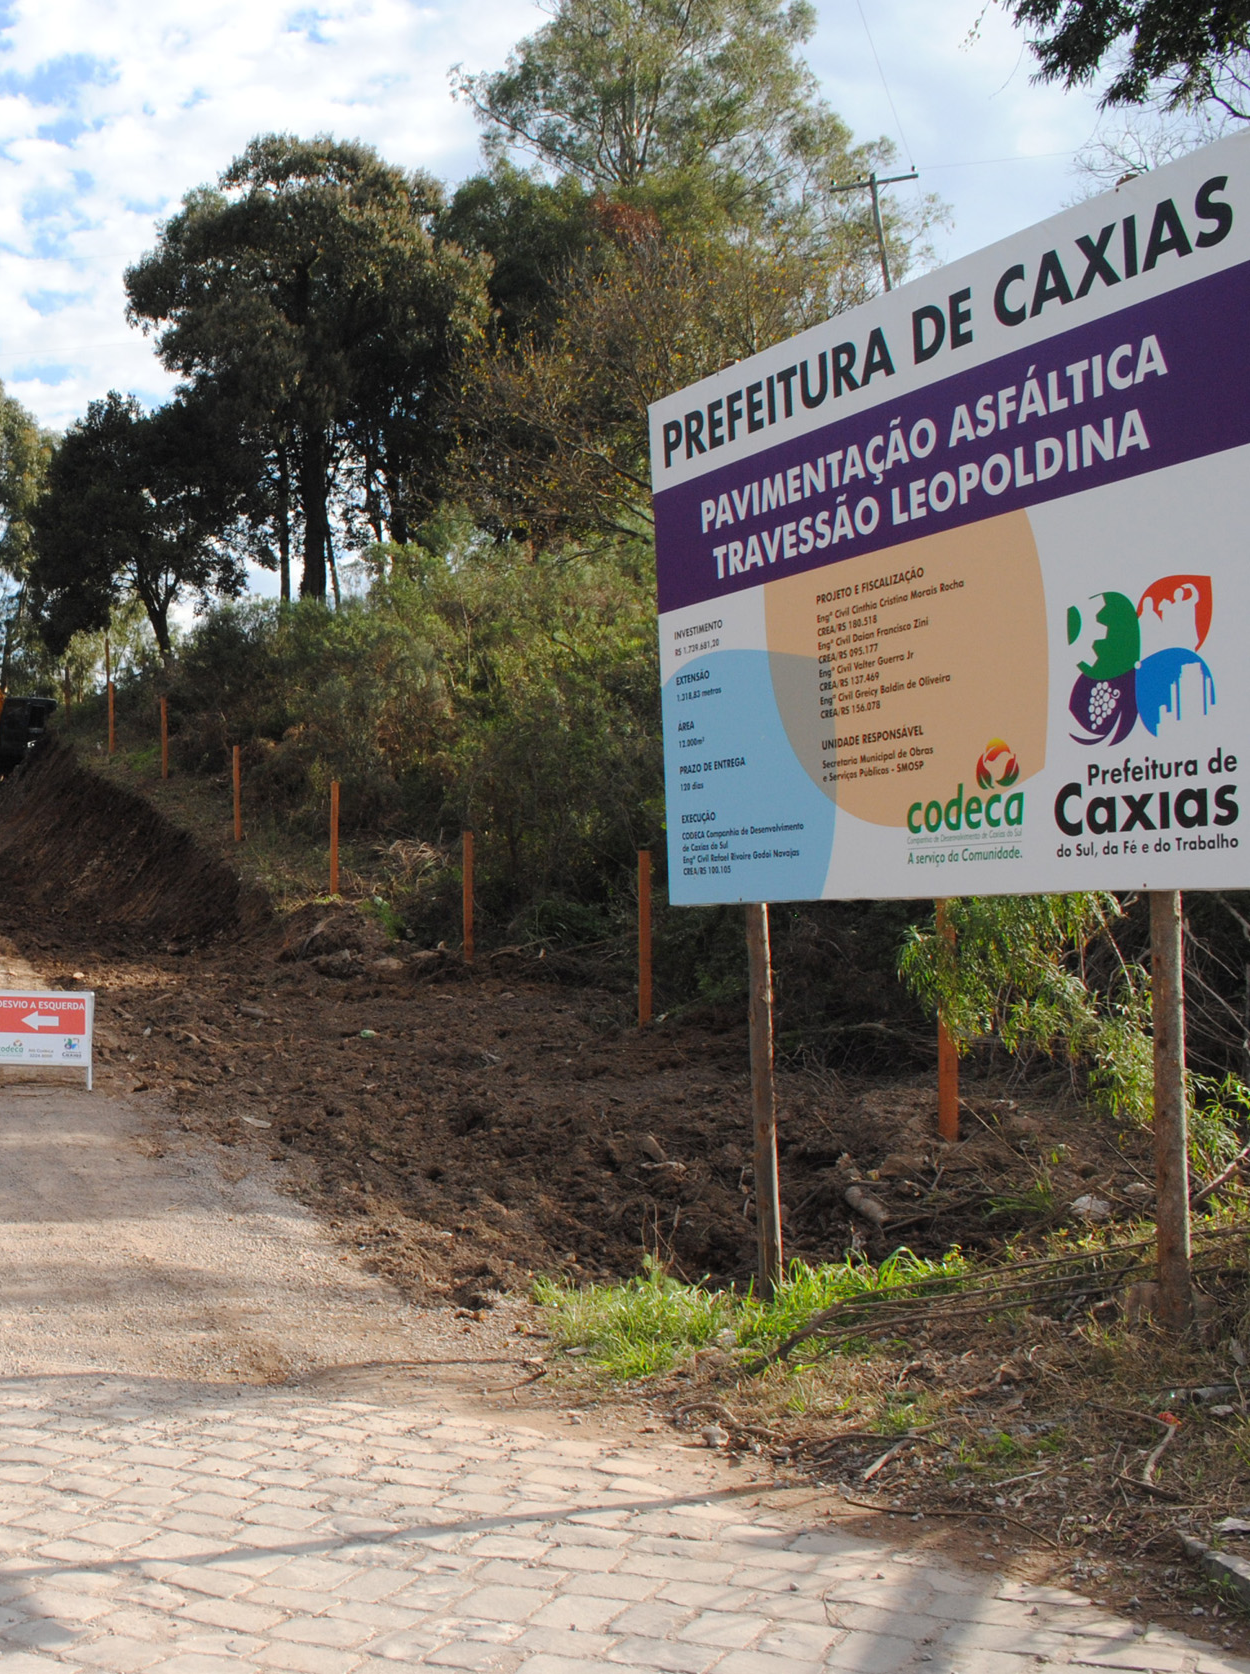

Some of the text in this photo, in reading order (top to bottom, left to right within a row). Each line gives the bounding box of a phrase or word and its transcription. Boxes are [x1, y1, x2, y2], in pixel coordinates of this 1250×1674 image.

[663, 175, 1233, 469] PREFEITURA DE CAXIAS
[701, 335, 1169, 534] PAVIMENTAÇÃO ASFÁLTICA
[713, 408, 1151, 580] TRAVESSÃO LEOPOLDINA
[816, 566, 924, 605] PROJETO E FISCALIZAÇÃO
[835, 608, 850, 619] Civil
[851, 601, 877, 614] Cinthia
[880, 594, 908, 608] Cristina
[910, 587, 938, 600] Morais
[940, 579, 965, 592] Rocha
[674, 619, 723, 640] INVESTIMENTO
[817, 615, 877, 637] CREA/RS 180.518
[836, 635, 850, 646] Civil
[853, 631, 875, 642] Daian
[877, 623, 911, 637] Francisco
[914, 617, 929, 628] Zini
[818, 643, 878, 664] CREA/RS 095.177
[837, 663, 852, 674] Civil
[854, 658, 875, 671] Valter
[878, 653, 904, 665] Guerra
[907, 650, 914, 660] Jr
[676, 669, 710, 685] EXTENSÃO
[819, 672, 880, 691] CREA/RS 137.469
[838, 691, 853, 701] Civil
[855, 687, 878, 699] Greicy
[880, 682, 905, 694] Baldin
[907, 679, 916, 689] de
[918, 673, 951, 687] Oliveira
[702, 687, 722, 697] metros
[821, 701, 881, 719] CREA/RS 156.078
[678, 720, 695, 732] ÁREA
[822, 725, 924, 750] UNIDADE RESPONSÁVEL
[679, 757, 746, 775] PRAZO DE ENTREGA
[822, 746, 934, 769] Secretaria Municipal de Obras
[1088, 747, 1237, 786] Prefeitura de
[829, 771, 857, 782] Serviços
[859, 766, 889, 777] Públicos
[896, 761, 924, 773] SMOSP
[680, 782, 704, 791] 120 dias
[681, 810, 716, 824] EXECUÇÃO
[907, 783, 1024, 834] codeca
[1054, 782, 1239, 836] Caxias
[682, 823, 804, 840] CODECA Companhia de Desenvolvimento
[691, 843, 709, 852] Caxias
[720, 841, 729, 849] Sul
[697, 855, 709, 863] Civil
[711, 853, 729, 861] Rafael
[753, 850, 771, 859] Godoi
[773, 849, 800, 858] Navajas
[907, 845, 1023, 867] A serviço da Comunidade.
[1057, 833, 1239, 858] do Sul, da Fé e do Trabalho
[683, 867, 706, 875] CREA/RS
[30, 1001, 36, 1009] A
[38, 1001, 85, 1011] ESQUERDA
